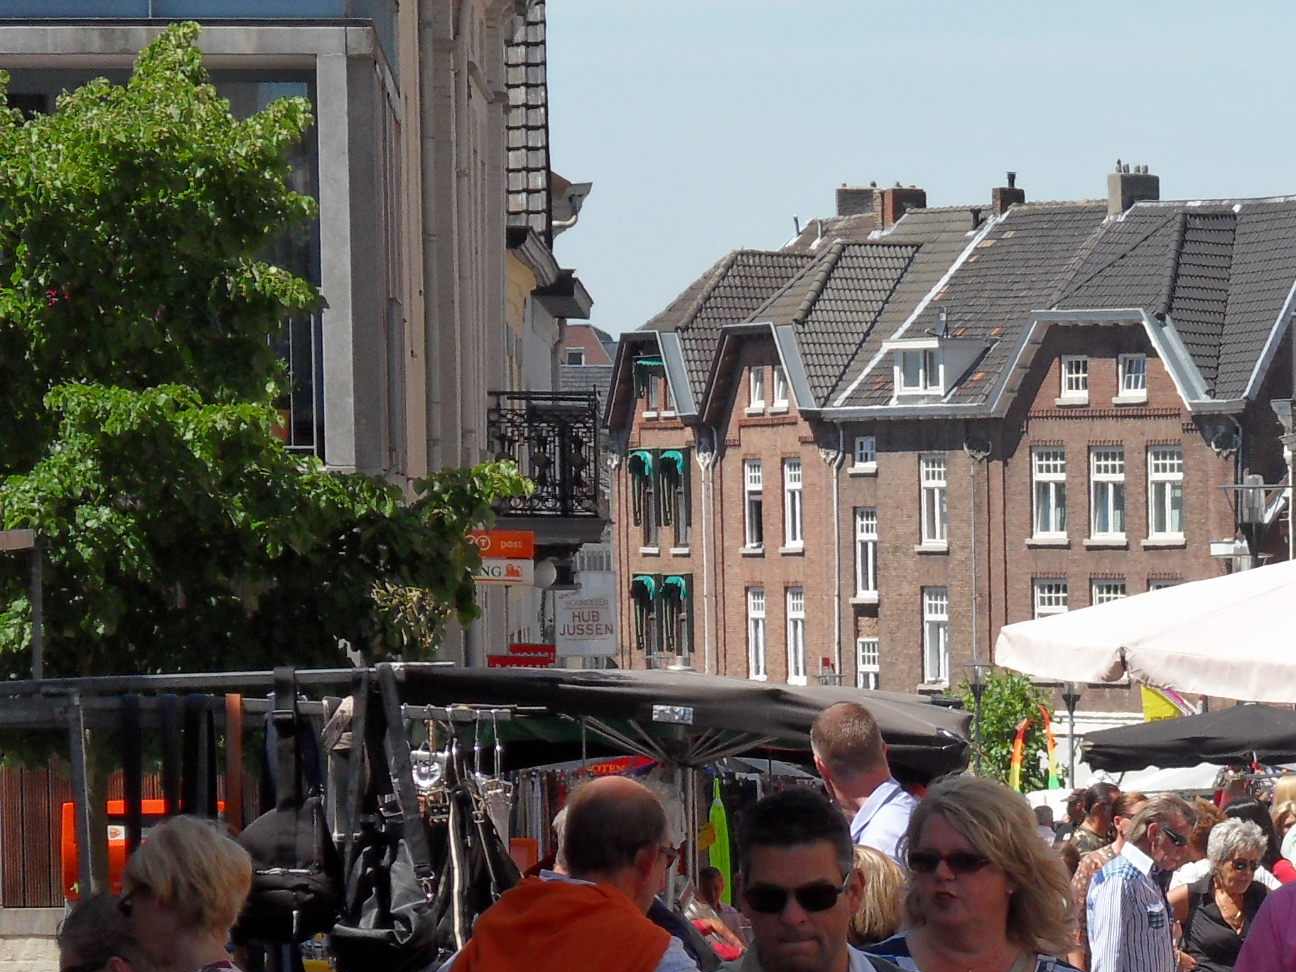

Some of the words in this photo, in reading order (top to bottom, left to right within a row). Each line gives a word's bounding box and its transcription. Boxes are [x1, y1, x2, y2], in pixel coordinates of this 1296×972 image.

[500, 540, 523, 550] post
[572, 610, 600, 622] HUB
[559, 623, 614, 636] JUSSEN
